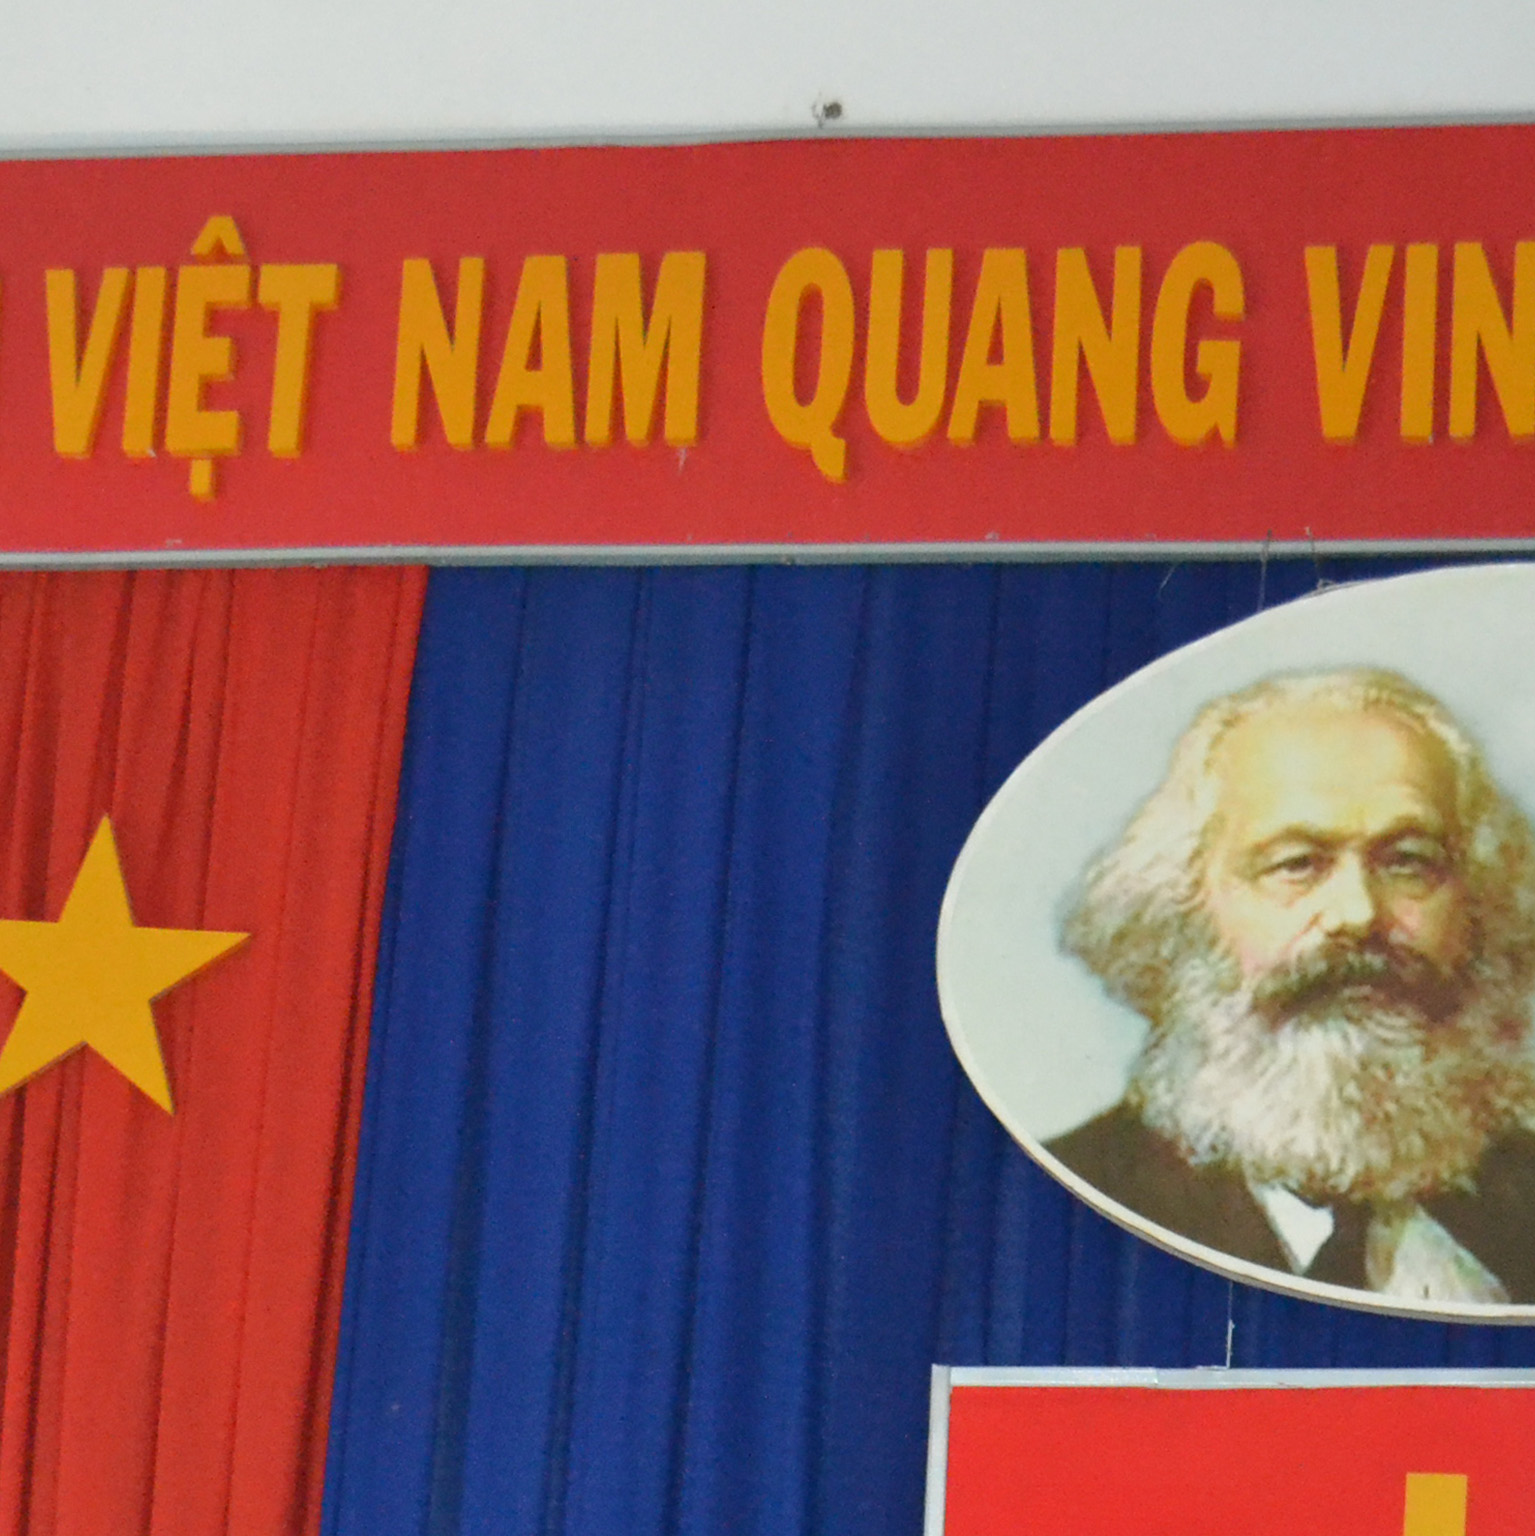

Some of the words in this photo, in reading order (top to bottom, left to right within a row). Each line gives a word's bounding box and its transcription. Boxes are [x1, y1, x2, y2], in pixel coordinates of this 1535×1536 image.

[44, 215, 340, 500] VIỆT
[389, 250, 707, 452] NAM
[760, 241, 1247, 482] QUANG
